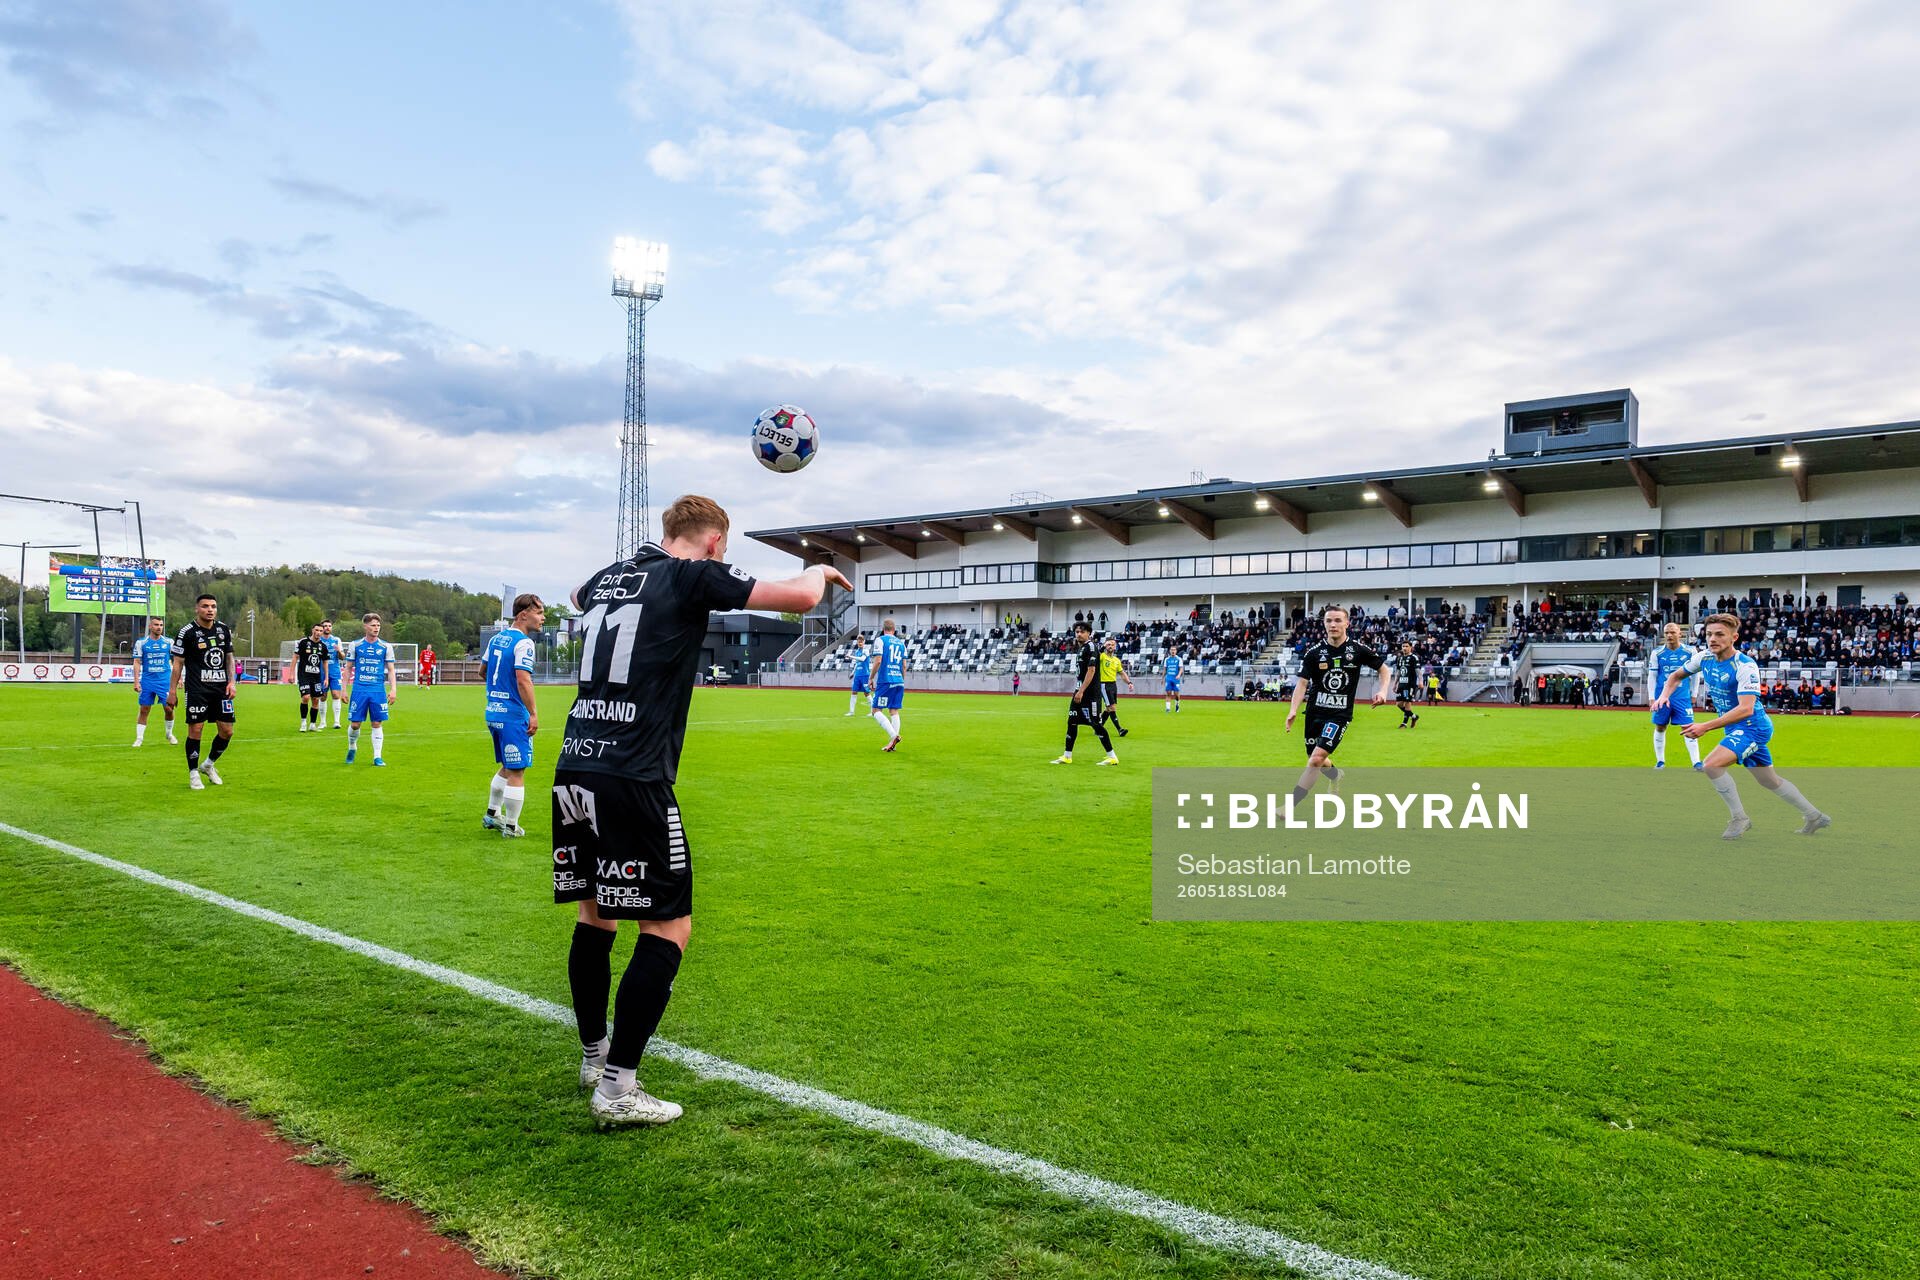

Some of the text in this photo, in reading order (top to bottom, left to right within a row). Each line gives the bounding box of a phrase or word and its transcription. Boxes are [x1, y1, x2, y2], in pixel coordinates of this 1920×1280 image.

[759, 426, 793, 447] SELECT
[580, 604, 643, 684] 11
[889, 645, 902, 664] 14
[493, 649, 502, 685] 7
[1315, 692, 1347, 706] MAXI
[596, 858, 648, 879] XACT
